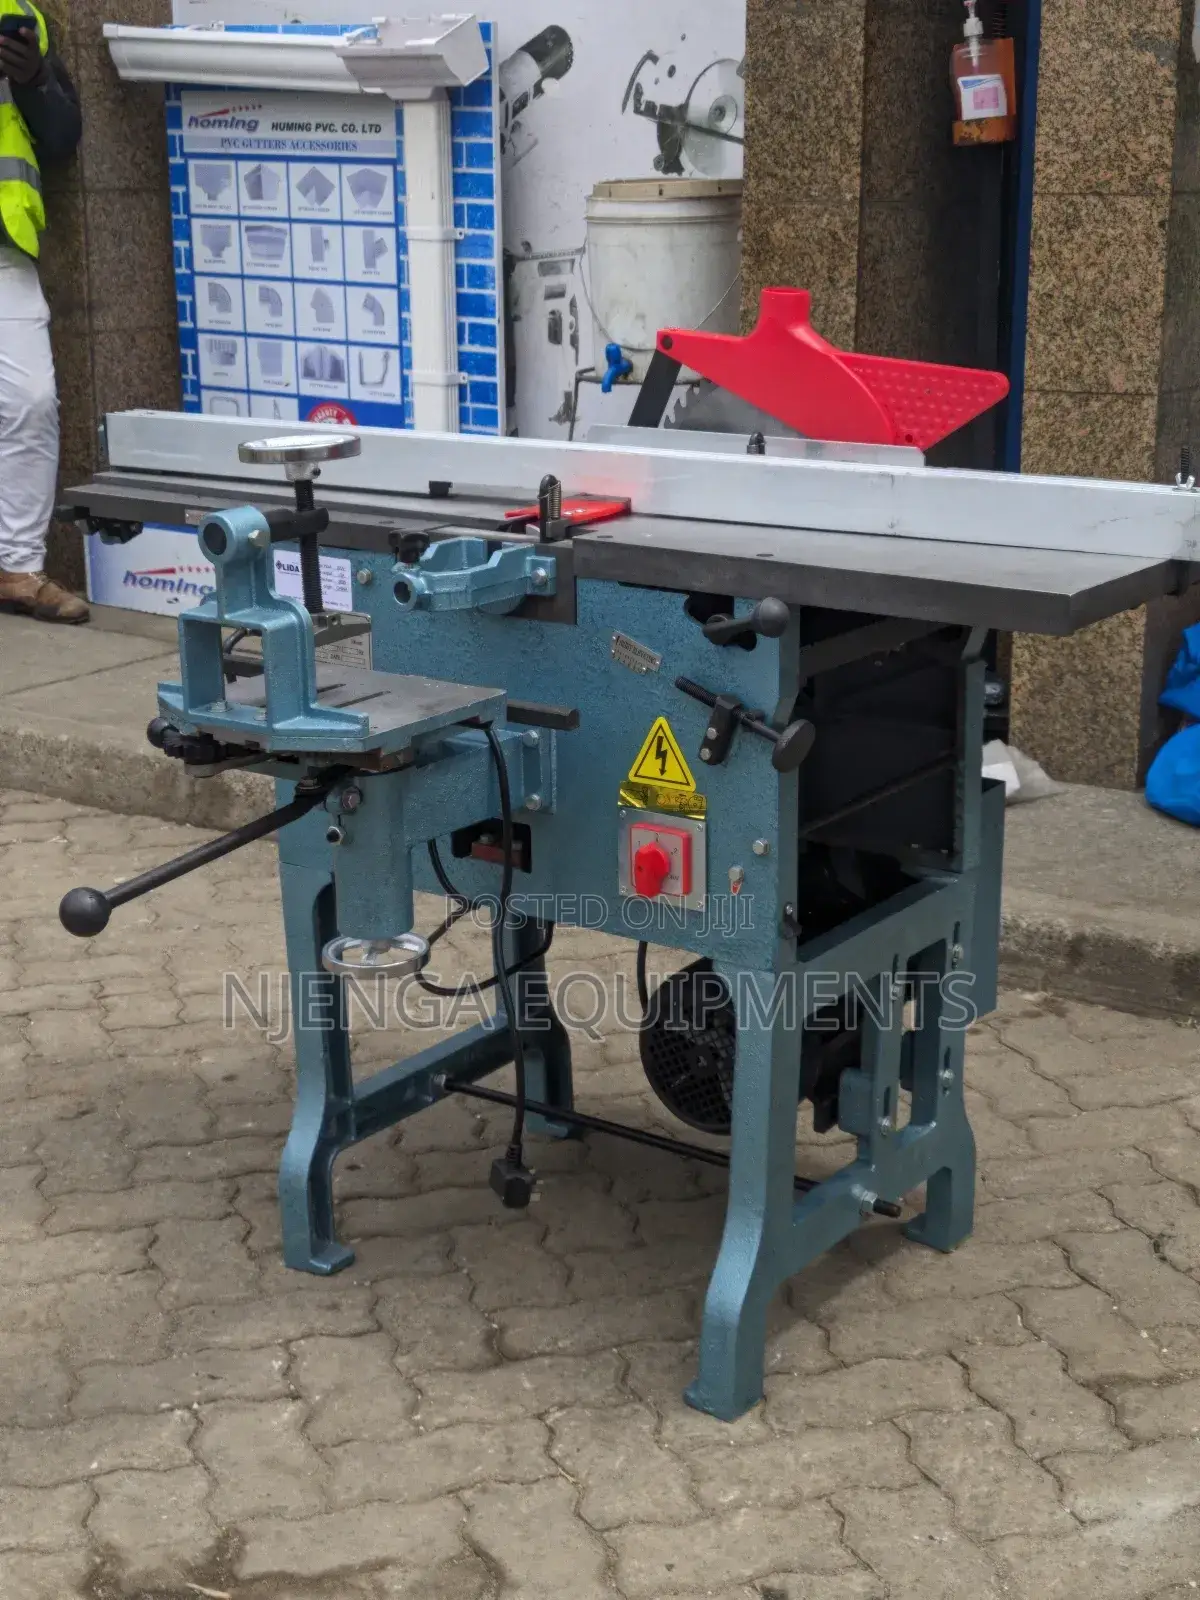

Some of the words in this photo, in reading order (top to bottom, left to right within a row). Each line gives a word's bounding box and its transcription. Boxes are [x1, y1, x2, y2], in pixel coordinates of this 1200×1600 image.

[188, 115, 260, 132] homing
[271, 121, 312, 133] HUMING
[314, 122, 338, 133] PVC.
[341, 123, 358, 133] CO.
[362, 123, 382, 134] LTD
[220, 137, 240, 149] PVC
[242, 138, 287, 150] GUTTERS
[289, 140, 358, 151] ACCESSORIES
[282, 563, 300, 573] LIDA
